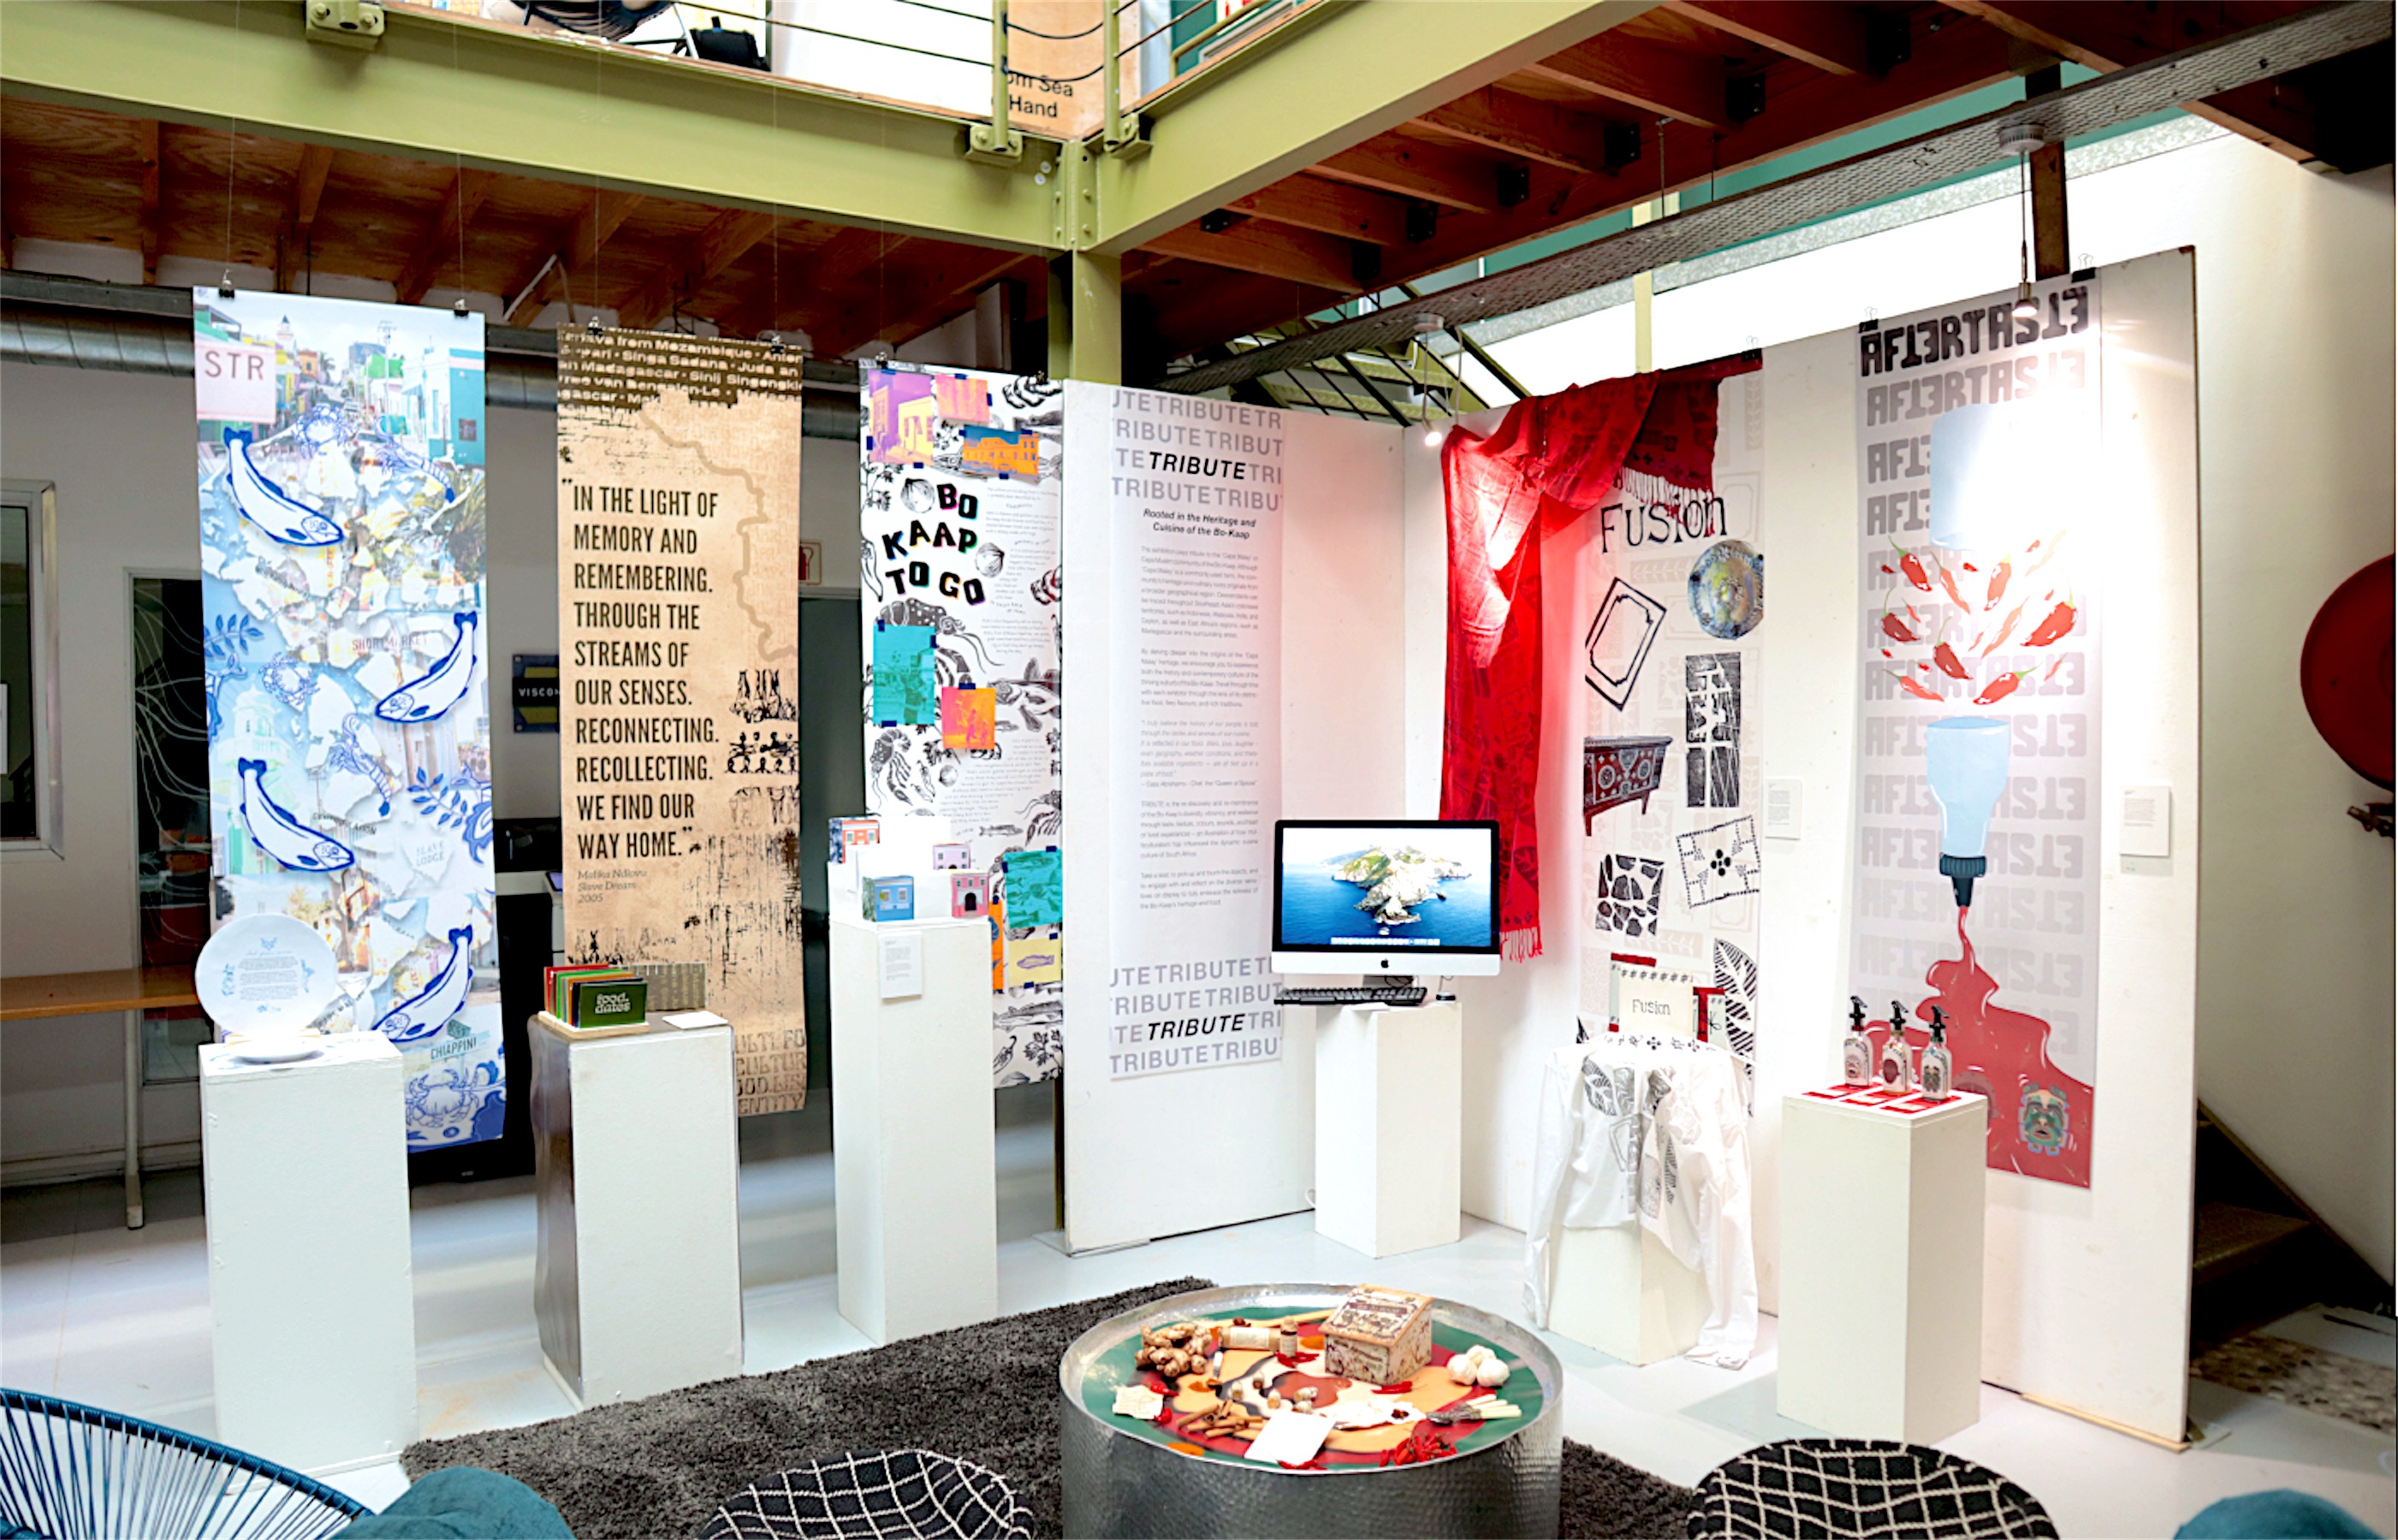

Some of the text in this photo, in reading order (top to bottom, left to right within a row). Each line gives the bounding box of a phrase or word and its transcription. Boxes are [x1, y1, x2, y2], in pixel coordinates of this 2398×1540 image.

[1039, 75, 1073, 97] Sea
[1010, 96, 1058, 117] Hand
[617, 335, 652, 349] from
[654, 339, 753, 359] Mozambique
[205, 350, 264, 381] STR
[581, 360, 680, 380] Madagascar
[1155, 394, 1251, 426] TRIBUTE
[1254, 408, 1281, 430] TR
[1113, 418, 1283, 457] RIBUTE TRIBUT
[1116, 447, 1282, 485] TE TRIBUTE TRI
[599, 487, 633, 513] THE
[640, 488, 692, 517] LIGHT
[697, 492, 719, 518] OF
[935, 483, 978, 521] BO
[1112, 477, 1283, 512] TRIBUTE TRIBU
[1143, 507, 1256, 528] Rooted in the Heritage and
[1153, 521, 1250, 540] Cuisine of the Bo-Kaap
[574, 524, 697, 554] MEMORY AND
[881, 518, 978, 561] KAAP
[573, 563, 713, 594] REMEMBERING.
[885, 560, 930, 595] TO
[939, 570, 987, 607] GO
[573, 601, 700, 631] THROUGH THE
[575, 641, 689, 667] STREAMS OF
[518, 687, 561, 697] VISCO
[575, 678, 692, 706] OUR SENSES.
[576, 717, 719, 744] RECONNECTING.
[576, 755, 713, 783] RECOLLECTING.
[577, 793, 695, 821] WE FIND OUR
[578, 833, 619, 860] WAY
[578, 893, 603, 904] 2005
[1155, 958, 1251, 984] TRIBUTE
[1111, 990, 1202, 1016] RIBUTE
[1631, 998, 1671, 1016] Fusion
[1114, 1010, 1281, 1045] TE TRIBUTE TRI
[1110, 1037, 1283, 1074] TRIBUTE TRIBU
